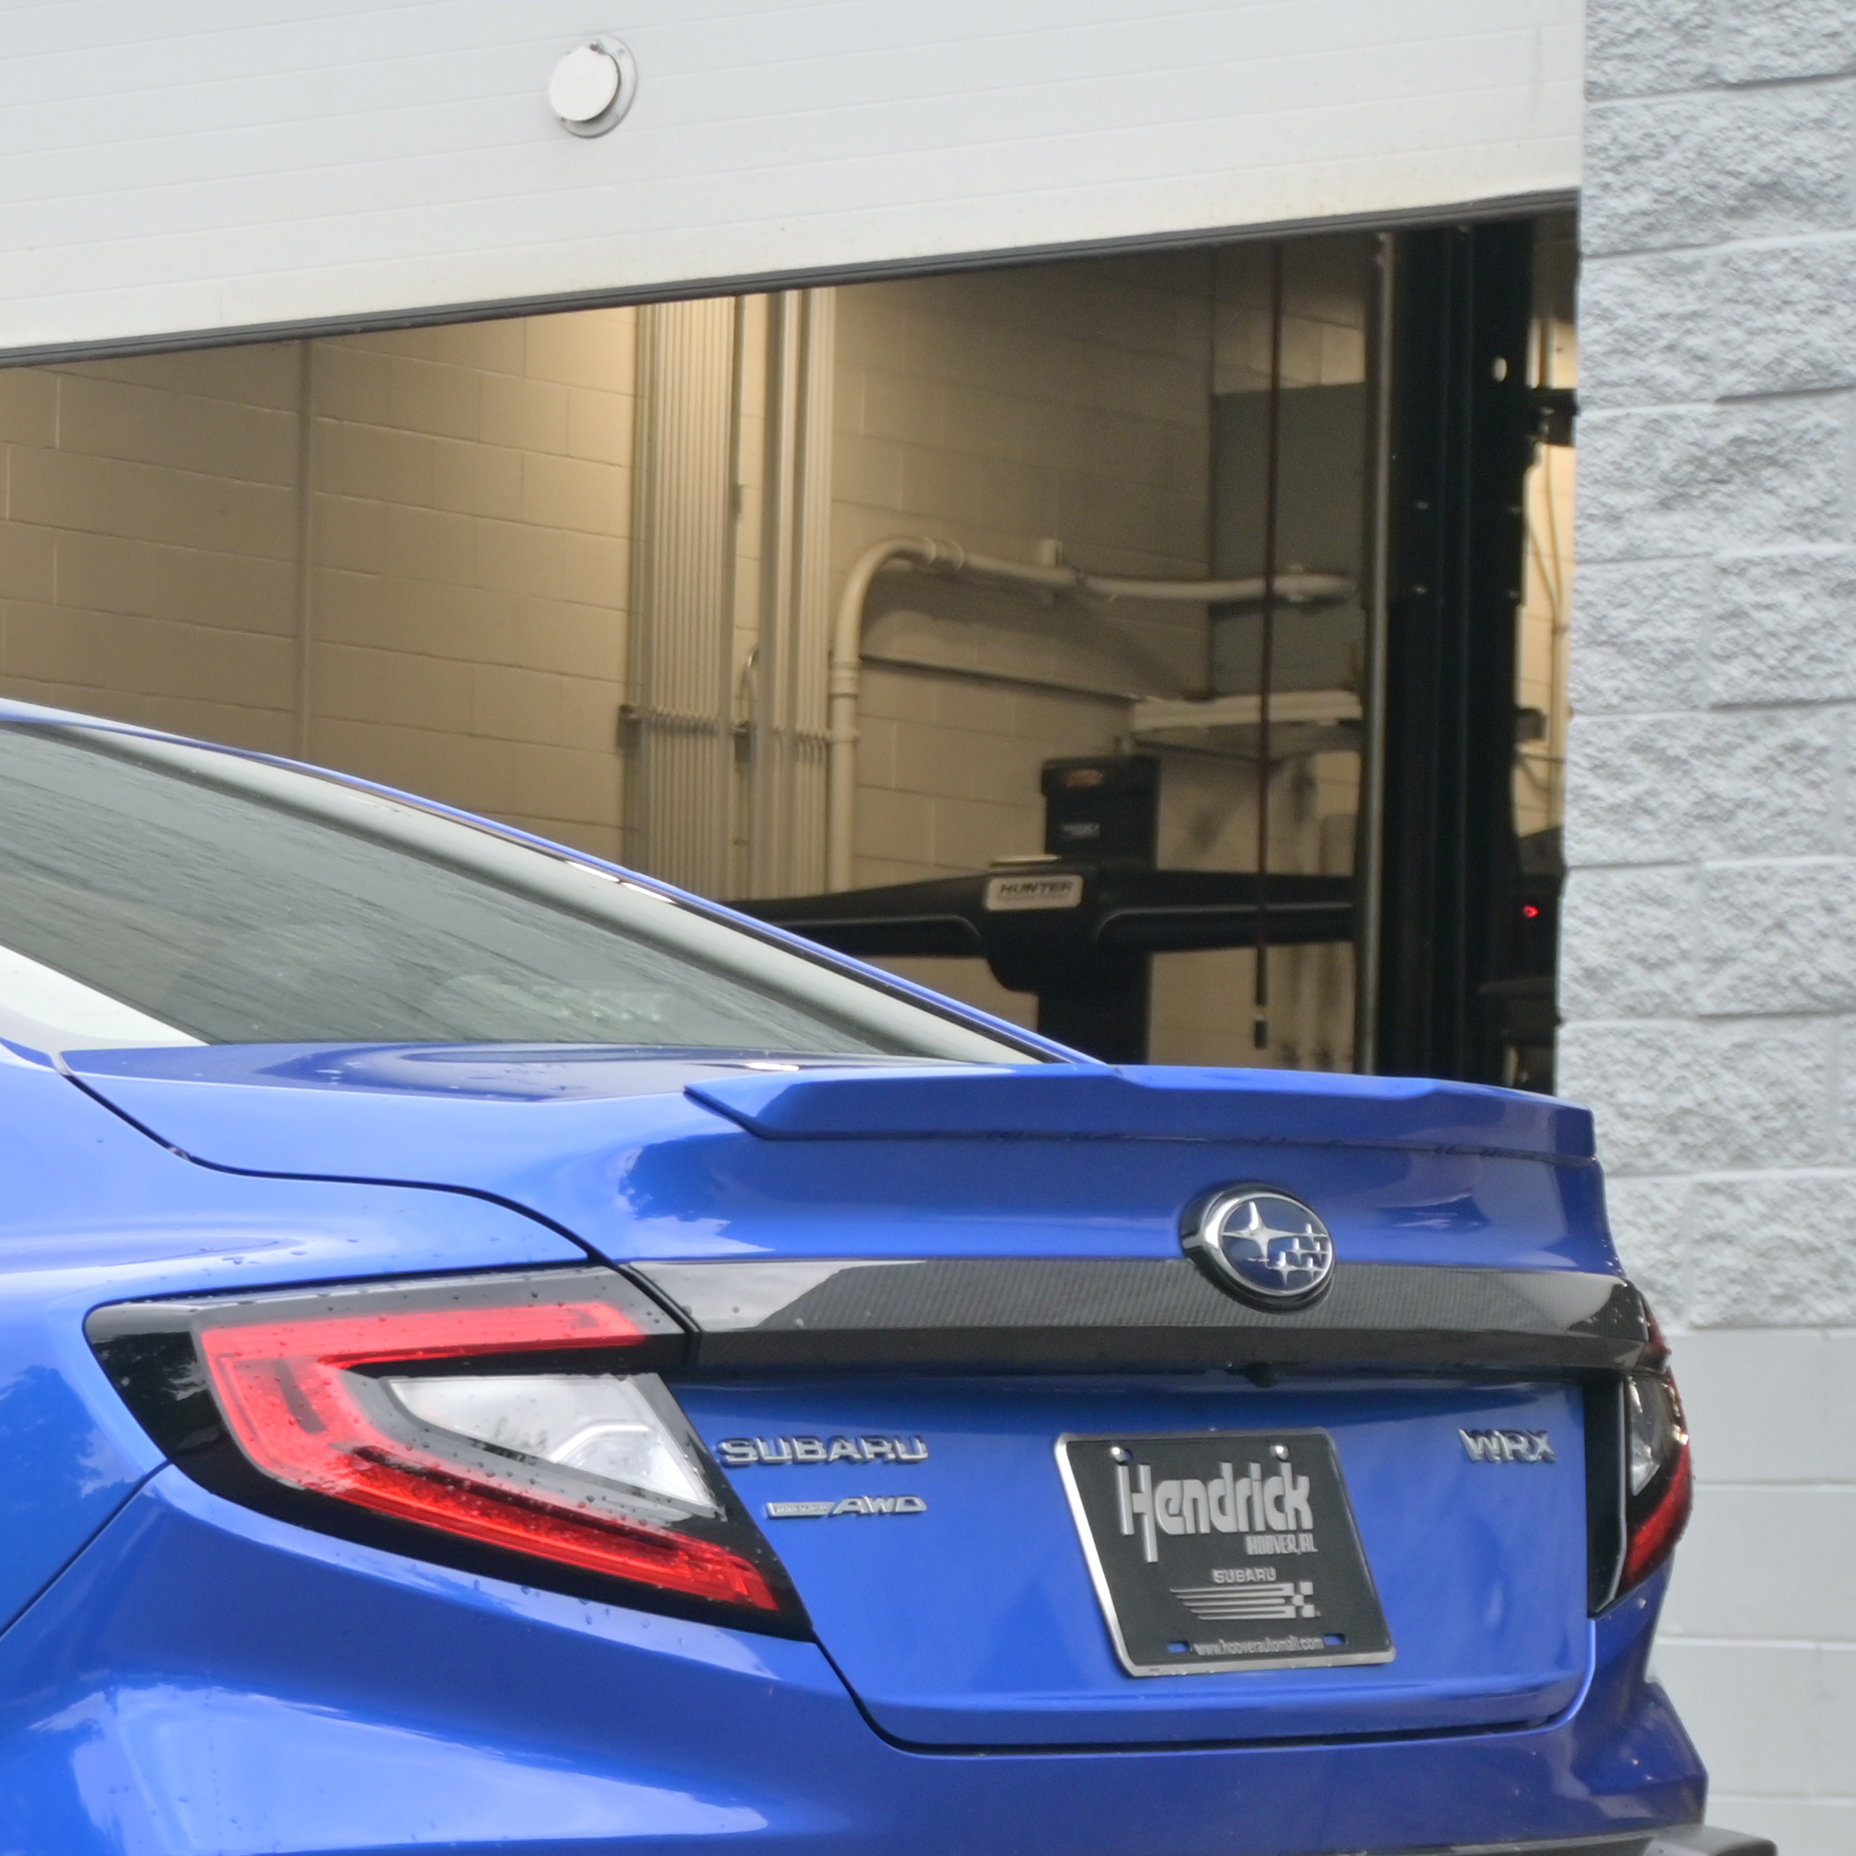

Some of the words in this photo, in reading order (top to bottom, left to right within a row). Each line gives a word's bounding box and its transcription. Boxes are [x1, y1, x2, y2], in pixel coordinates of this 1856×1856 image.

[999, 882, 1074, 893] HUNTER
[718, 1434, 929, 1466] SUBARU
[1457, 1428, 1557, 1463] WRX
[829, 1495, 928, 1516] AWD
[1116, 1462, 1314, 1563] Hendrick
[1212, 1567, 1277, 1582] SUBARU
